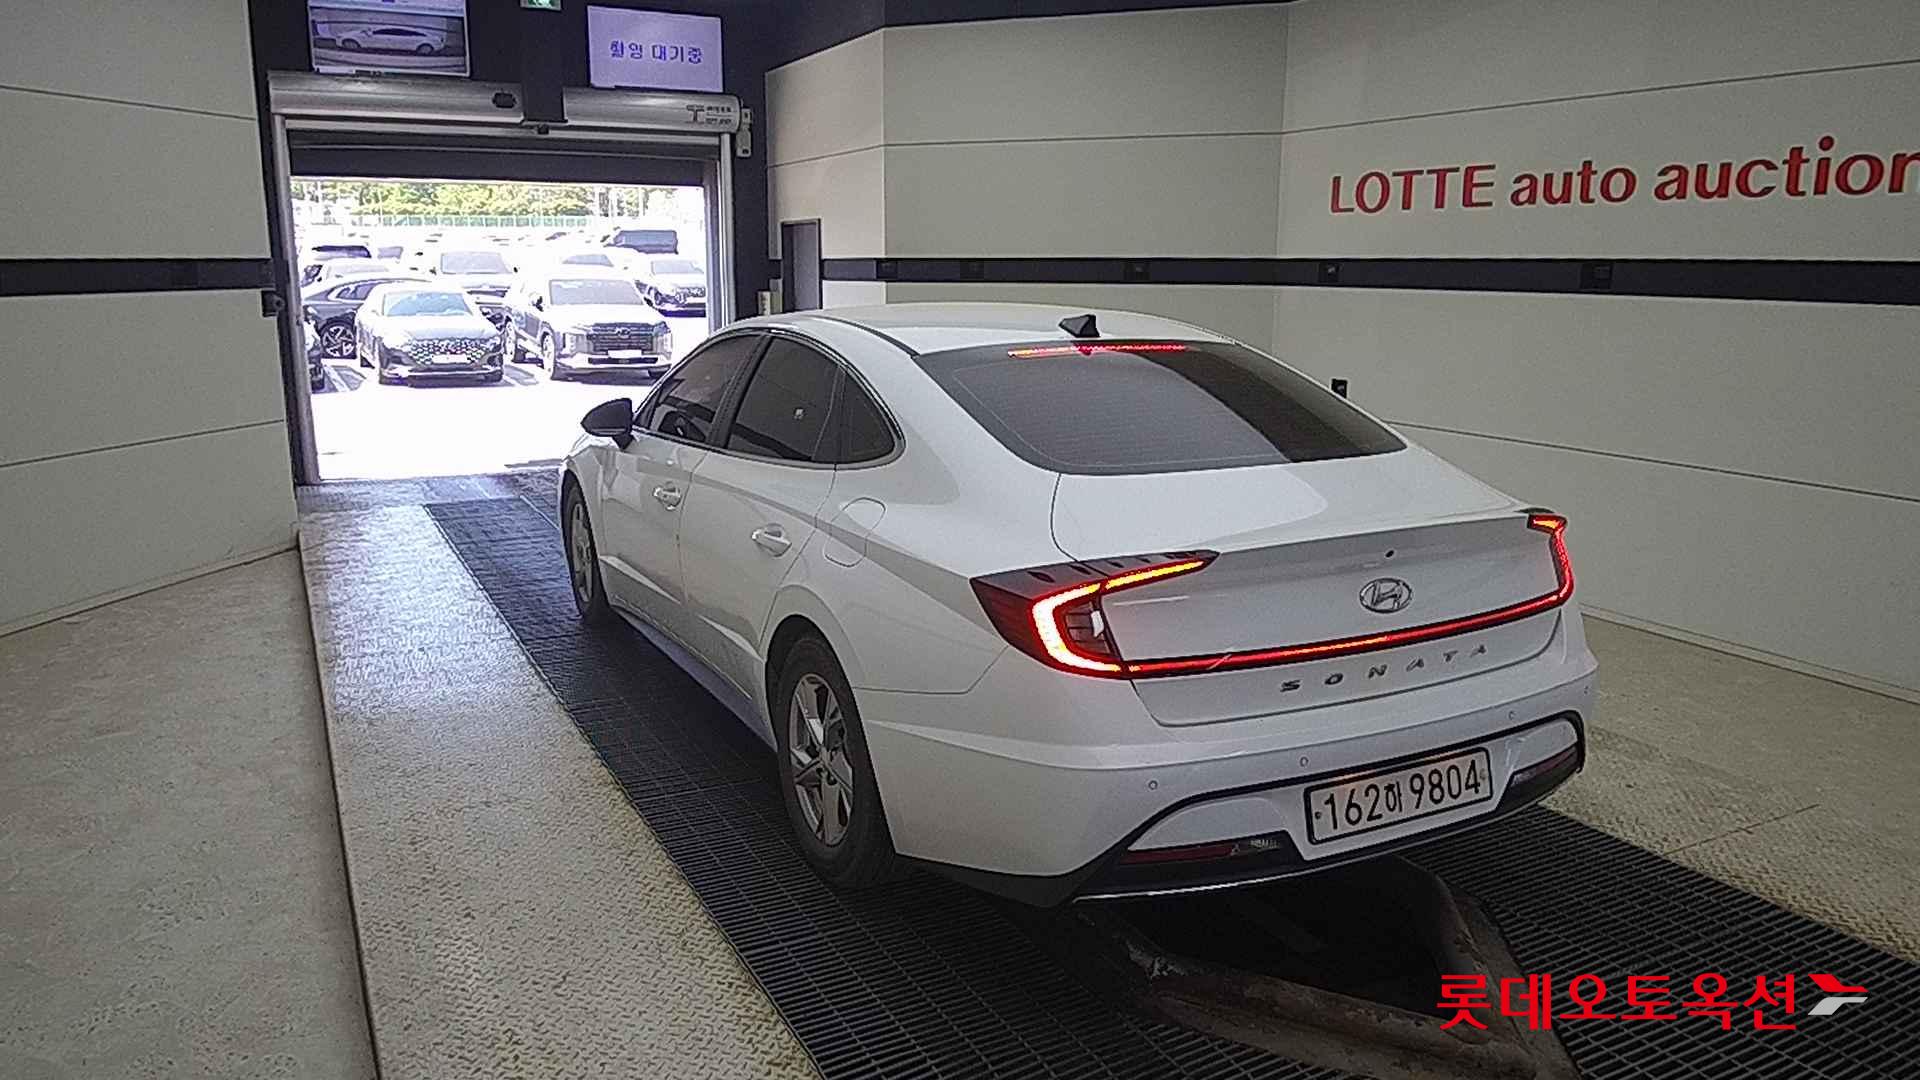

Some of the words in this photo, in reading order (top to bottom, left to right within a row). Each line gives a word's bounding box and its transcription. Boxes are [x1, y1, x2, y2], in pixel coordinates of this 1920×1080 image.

[651, 44, 703, 65] 대기중
[1329, 163, 1496, 215] LOTTE
[1510, 159, 1637, 207] auto
[1280, 645, 1487, 692] SONATA
[1323, 781, 1404, 830] 162하
[1409, 759, 1482, 811] 9804
